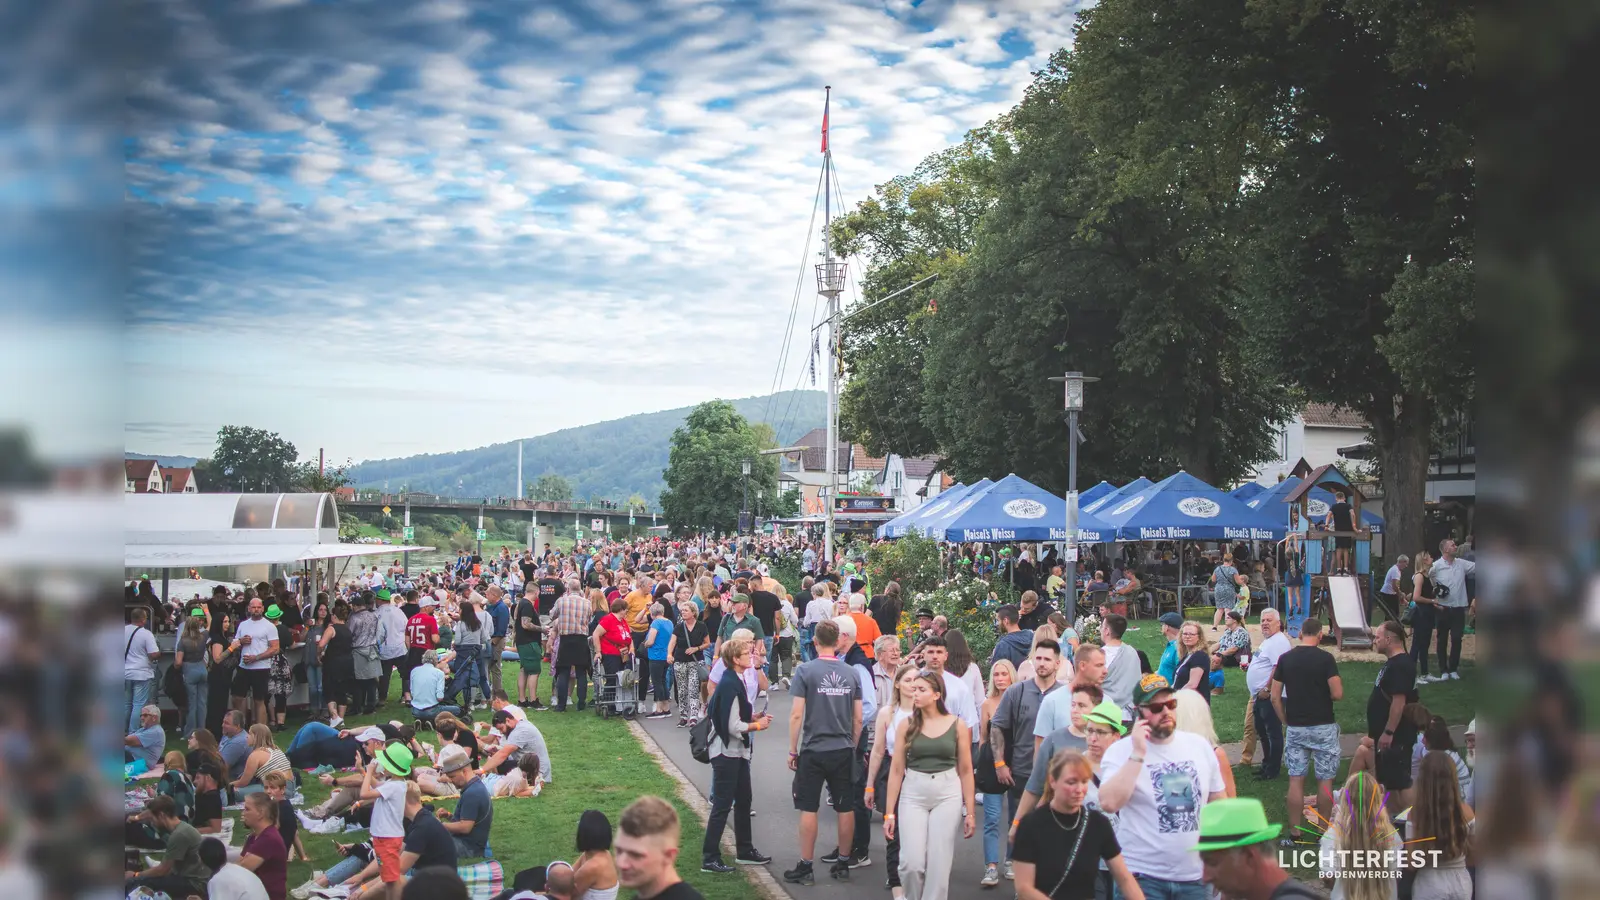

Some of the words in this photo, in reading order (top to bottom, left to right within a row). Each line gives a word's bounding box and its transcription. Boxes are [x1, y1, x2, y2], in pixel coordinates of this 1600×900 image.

[963, 528, 990, 540] Maisel's
[991, 528, 1015, 540] Weisse
[1140, 527, 1166, 539] Maisel's
[1167, 526, 1190, 538] Weisse
[1223, 526, 1249, 538] Maisel's
[1250, 527, 1273, 539] Weisse
